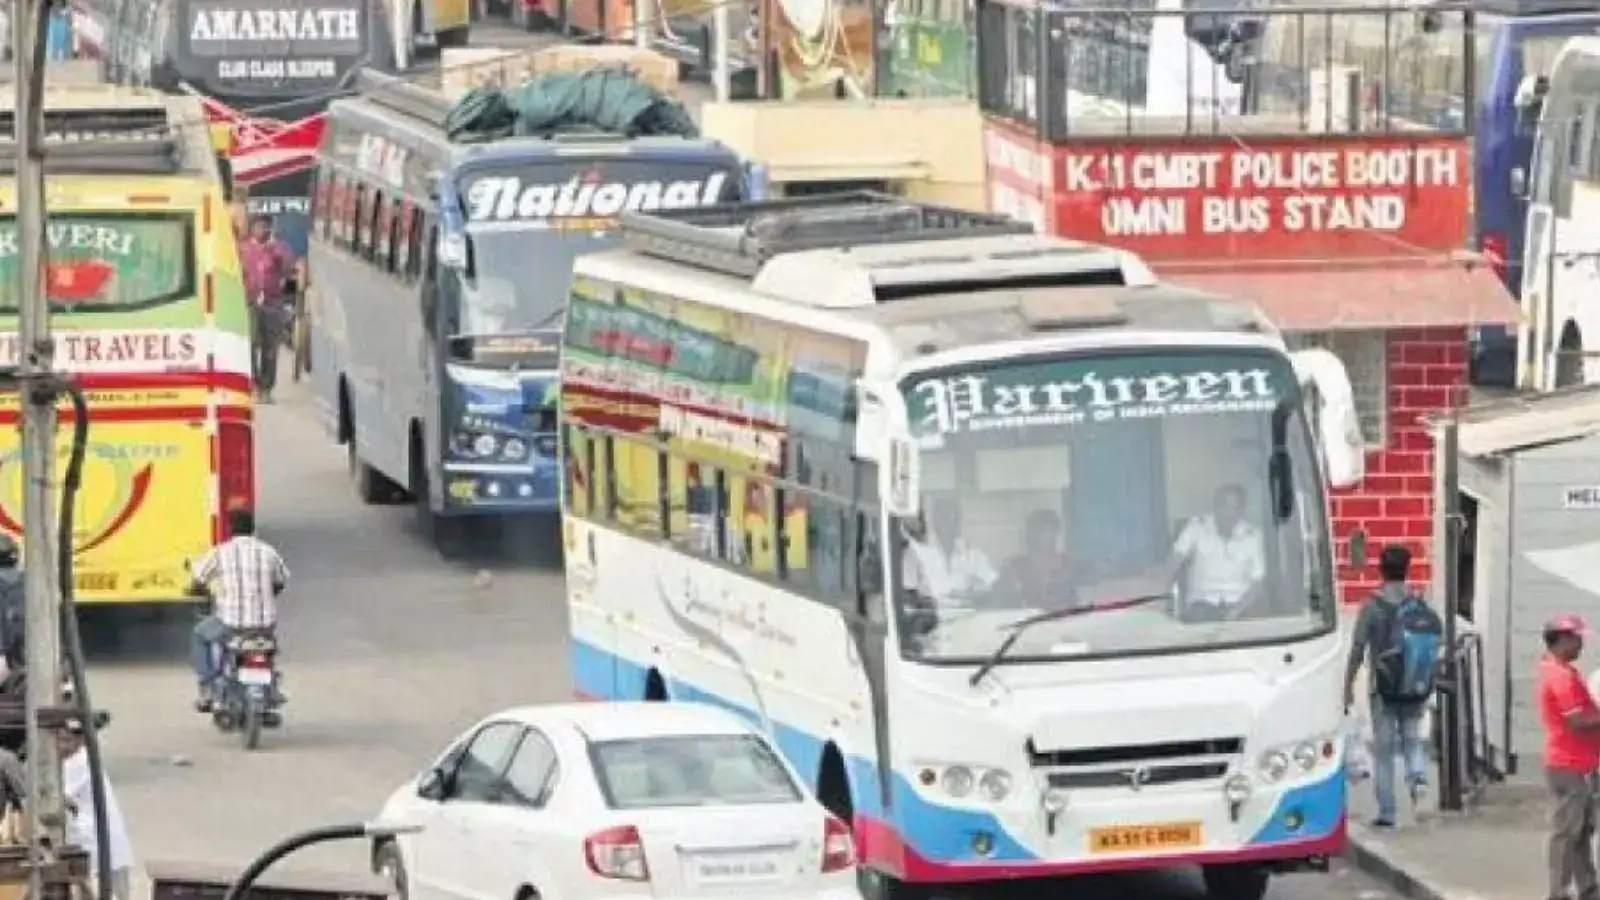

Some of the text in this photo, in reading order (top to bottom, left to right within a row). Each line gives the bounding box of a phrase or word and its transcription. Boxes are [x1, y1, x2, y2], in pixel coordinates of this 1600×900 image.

[191, 9, 359, 40] AMARNATH
[1133, 152, 1222, 189] CMBT
[1231, 150, 1339, 188] POLICE
[1345, 147, 1457, 186] BOOTH
[467, 171, 729, 220] National
[1102, 194, 1405, 235] OMNI BUS STAND
[65, 333, 196, 362] TRAVELS
[913, 367, 1276, 433] Parveen
